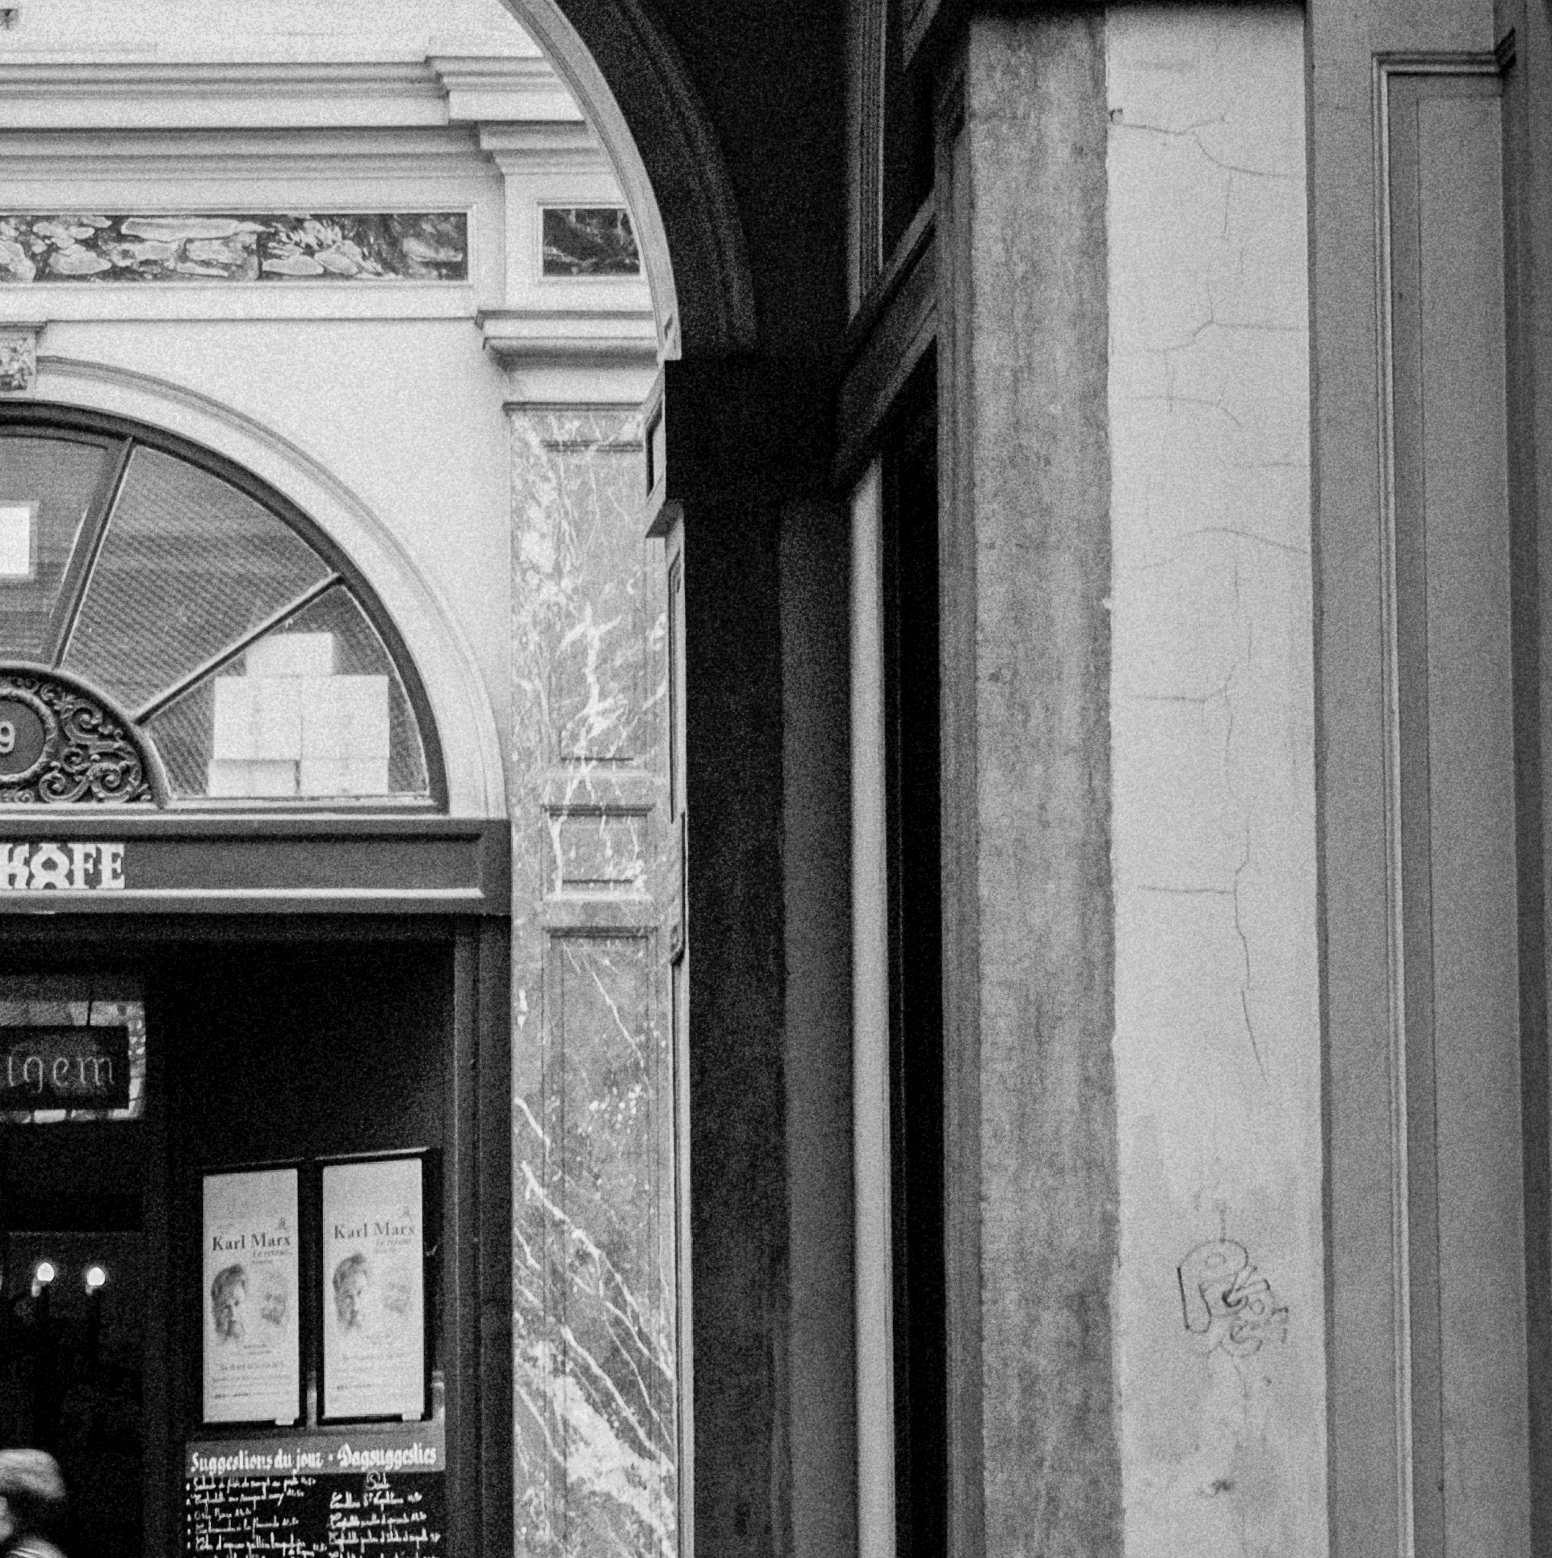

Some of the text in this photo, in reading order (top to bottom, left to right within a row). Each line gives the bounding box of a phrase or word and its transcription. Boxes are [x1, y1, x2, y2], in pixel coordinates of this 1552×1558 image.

[333, 1219, 415, 1240] Karl Marx
[212, 1231, 291, 1252] Karl Marx
[190, 1442, 438, 1477] Suggestions du jour Dagsuggesties
